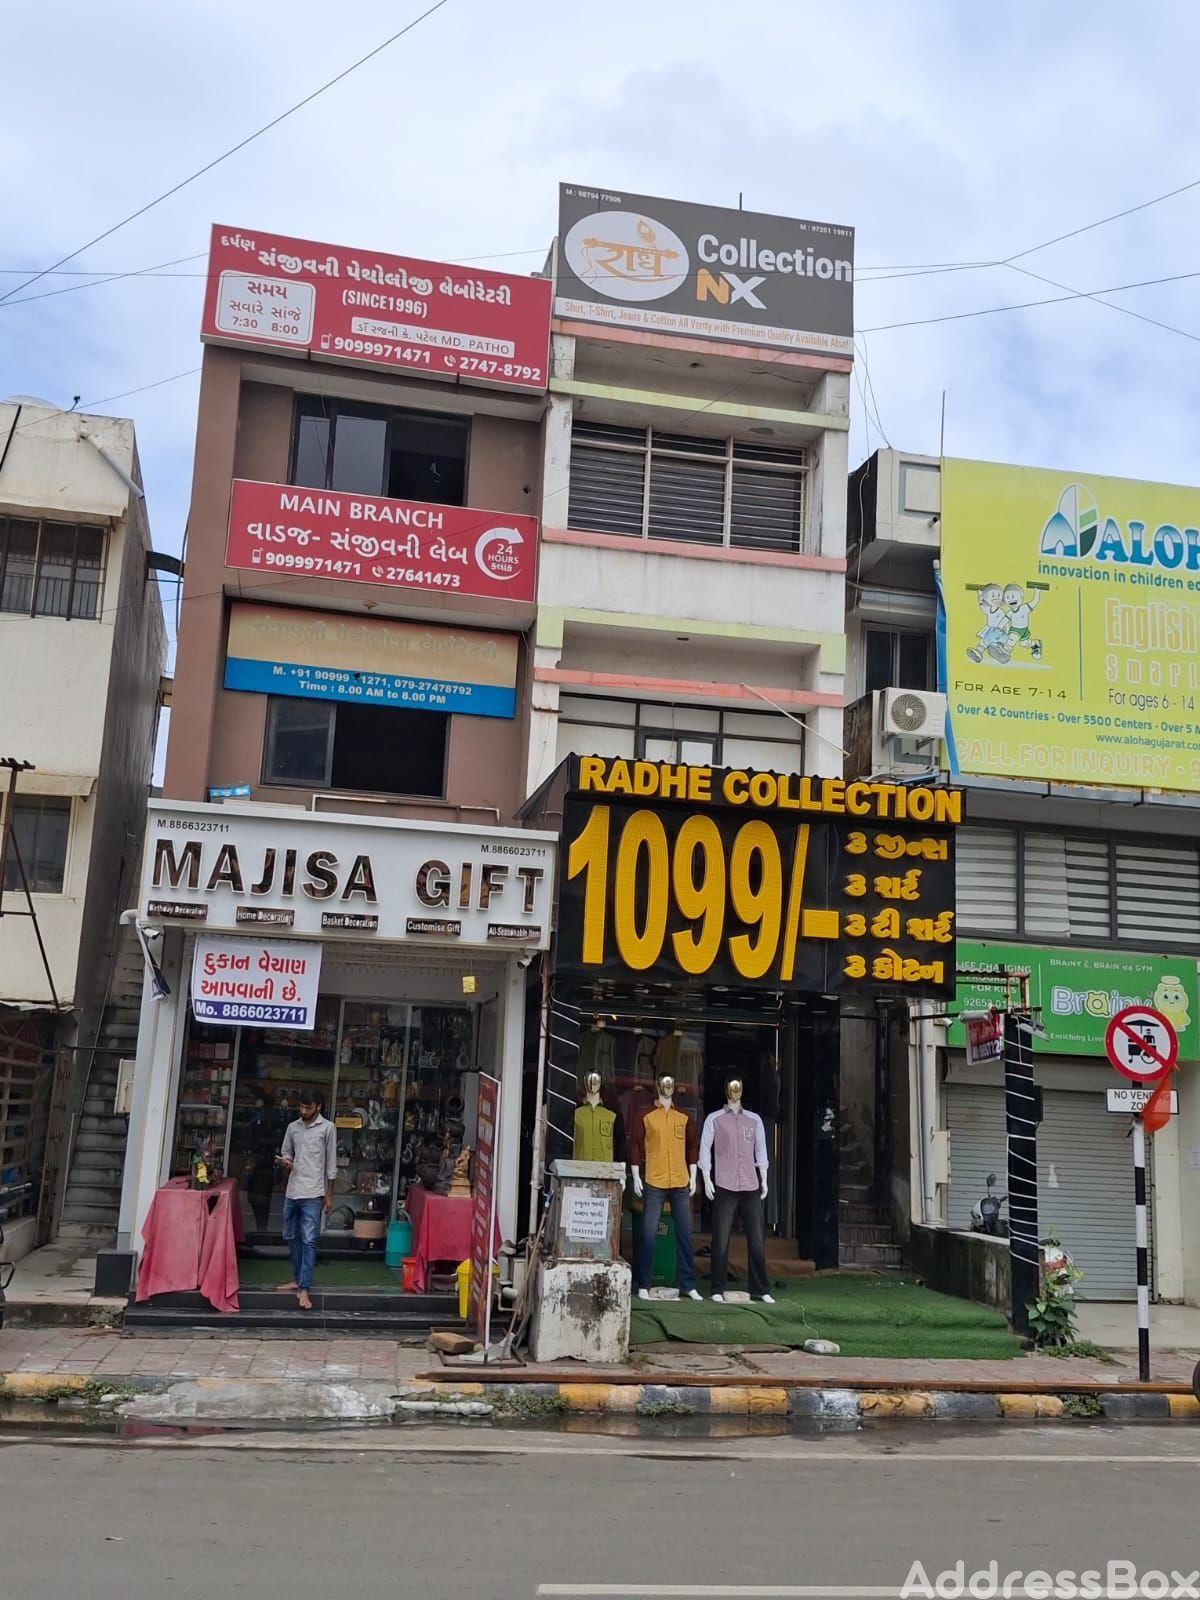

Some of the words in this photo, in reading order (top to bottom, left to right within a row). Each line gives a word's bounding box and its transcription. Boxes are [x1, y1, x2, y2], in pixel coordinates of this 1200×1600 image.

[221, 234, 256, 252] દર્પણ
[697, 234, 852, 283] Collection
[258, 247, 340, 278] સંજીવની
[346, 260, 433, 296] પેથોલોજી
[439, 275, 511, 306] લેબોરેટરી
[696, 267, 767, 310] NX
[247, 281, 288, 300] સમય
[228, 300, 264, 315] સવારે
[271, 306, 302, 321] સાંજે
[342, 289, 428, 319] (SINCE1996)
[232, 315, 258, 329] 7:30
[271, 322, 299, 335] 8:00
[564, 301, 587, 316] Shirt,
[588, 304, 617, 320] T-Shirt,
[618, 309, 641, 322] Jeans
[643, 313, 649, 321] &
[650, 314, 677, 327] Cotton
[679, 318, 689, 328] All
[715, 322, 731, 333] with
[732, 324, 766, 339] Premium
[767, 329, 794, 345] Quality
[795, 332, 829, 345] Available
[830, 337, 850, 350] Also!
[372, 326, 398, 338] રજની
[416, 331, 438, 343] પટેલ
[441, 335, 464, 348] MD.
[469, 339, 509, 355] PATHO
[334, 336, 431, 364] 9099971471
[459, 357, 541, 381] 2747-8792
[279, 493, 341, 517] MAIN
[350, 502, 443, 530] BRANCH
[330, 528, 420, 558] સંજીવની
[430, 536, 468, 565] લેબ
[496, 543, 513, 555] 24
[265, 552, 361, 576] 9099971471
[386, 567, 460, 588] 27641473
[488, 554, 519, 565] HOURS
[1037, 560, 1110, 581] innovation
[1114, 568, 1126, 583] in
[1130, 571, 1183, 588] children
[272, 665, 287, 676] M.
[290, 668, 311, 678] +91
[315, 670, 350, 683] 90999
[354, 673, 391, 688] 1271,
[394, 679, 473, 696] 079-27478792
[299, 680, 327, 692] Time
[337, 684, 363, 695] 8.00
[365, 687, 384, 697] AM
[387, 690, 399, 699] to
[401, 691, 426, 702] 8.00
[428, 694, 447, 705] PM
[1028, 687, 1067, 700] 7-14
[1108, 688, 1126, 706] For
[1129, 693, 1160, 711] ages
[1161, 693, 1170, 710] 6
[1182, 695, 1195, 711] 14
[957, 703, 981, 715] Over
[983, 706, 997, 716] 42
[1000, 708, 1049, 721] Countries
[1057, 712, 1081, 724] Over
[1083, 714, 1111, 727] 5500
[1114, 718, 1153, 731] Centers
[1160, 722, 1184, 733] Over
[1186, 724, 1193, 734] 5
[957, 739, 1014, 767] CALL
[1018, 743, 1067, 770] FOR
[1071, 748, 1171, 779] INQUIRY
[578, 756, 712, 801] RADHE
[722, 771, 962, 823] COLLECTION
[156, 819, 230, 833] M.8866323711
[480, 844, 546, 857] M.8866023711
[873, 833, 948, 861] જીન્સ
[151, 838, 379, 904] MAJISA
[414, 859, 545, 915] GIFT
[567, 804, 840, 982] 1099/-
[174, 906, 206, 916] Decoration
[237, 911, 257, 920] Home
[258, 912, 293, 925] Decoration
[322, 915, 344, 926] Basket
[345, 916, 377, 929] Decoration
[870, 907, 900, 939] ટી
[407, 921, 446, 932] Customise
[447, 923, 461, 932] Gift
[203, 952, 250, 975] દુકાન
[258, 950, 306, 975] વેચાણ
[871, 947, 944, 985] કોટન
[1050, 959, 1082, 967] BRAINY
[201, 978, 274, 1001] આપવાની
[282, 980, 302, 1002] છે.
[994, 985, 1017, 993] KIS
[195, 1001, 218, 1016] Mo.
[222, 1004, 305, 1021] 8866023711
[1050, 1033, 1086, 1042] Enriching
[1114, 1091, 1128, 1099] NO
[1130, 1091, 1171, 1101] VENNG
